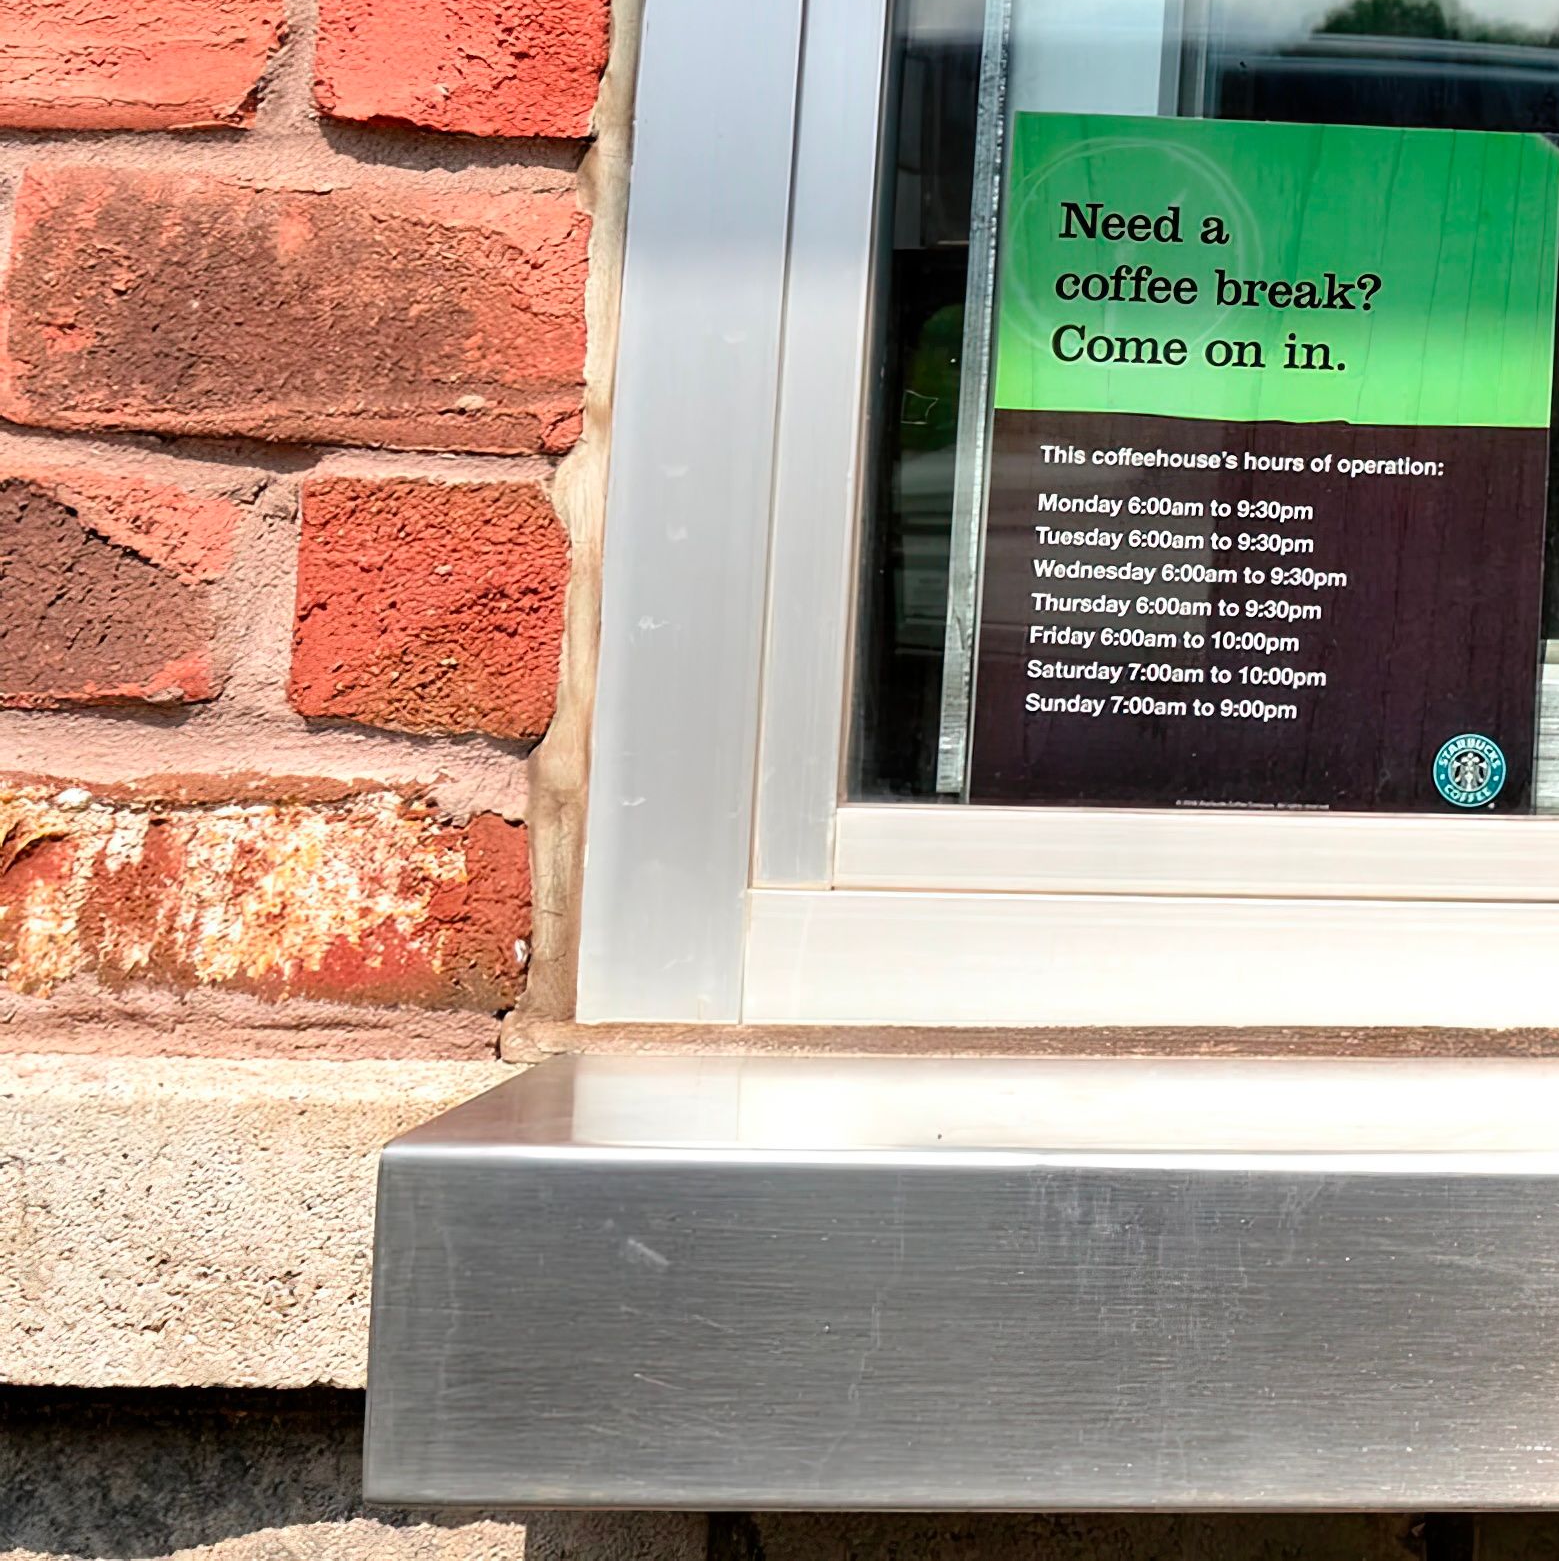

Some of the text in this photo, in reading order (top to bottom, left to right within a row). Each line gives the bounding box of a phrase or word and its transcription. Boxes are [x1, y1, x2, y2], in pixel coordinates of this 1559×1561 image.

[1058, 202, 1230, 245] Need a
[1055, 265, 1382, 311] coffee break?
[1052, 325, 1346, 371] Come on in.
[1041, 445, 1445, 478] This coffeehouse's hours of operation:
[1037, 493, 1314, 522] Monday 6:00am to 9:30pm
[1035, 526, 1314, 555] Tuesday 6:00am to 9:30pm
[1033, 559, 1347, 590] Wednesday 6:00am to 9:30pm
[1031, 592, 1322, 623] Thursday 6:00am to 9:30pm
[1029, 626, 1299, 654] Friday 6:00am to 10:00pm
[1026, 660, 1327, 689] Saturday 7:00am to 10:00pm
[1025, 693, 1298, 722] Sunday 7:00am to 9:00pm
[1439, 737, 1501, 769] STARBUCKS
[1444, 783, 1492, 803] COFFEE
